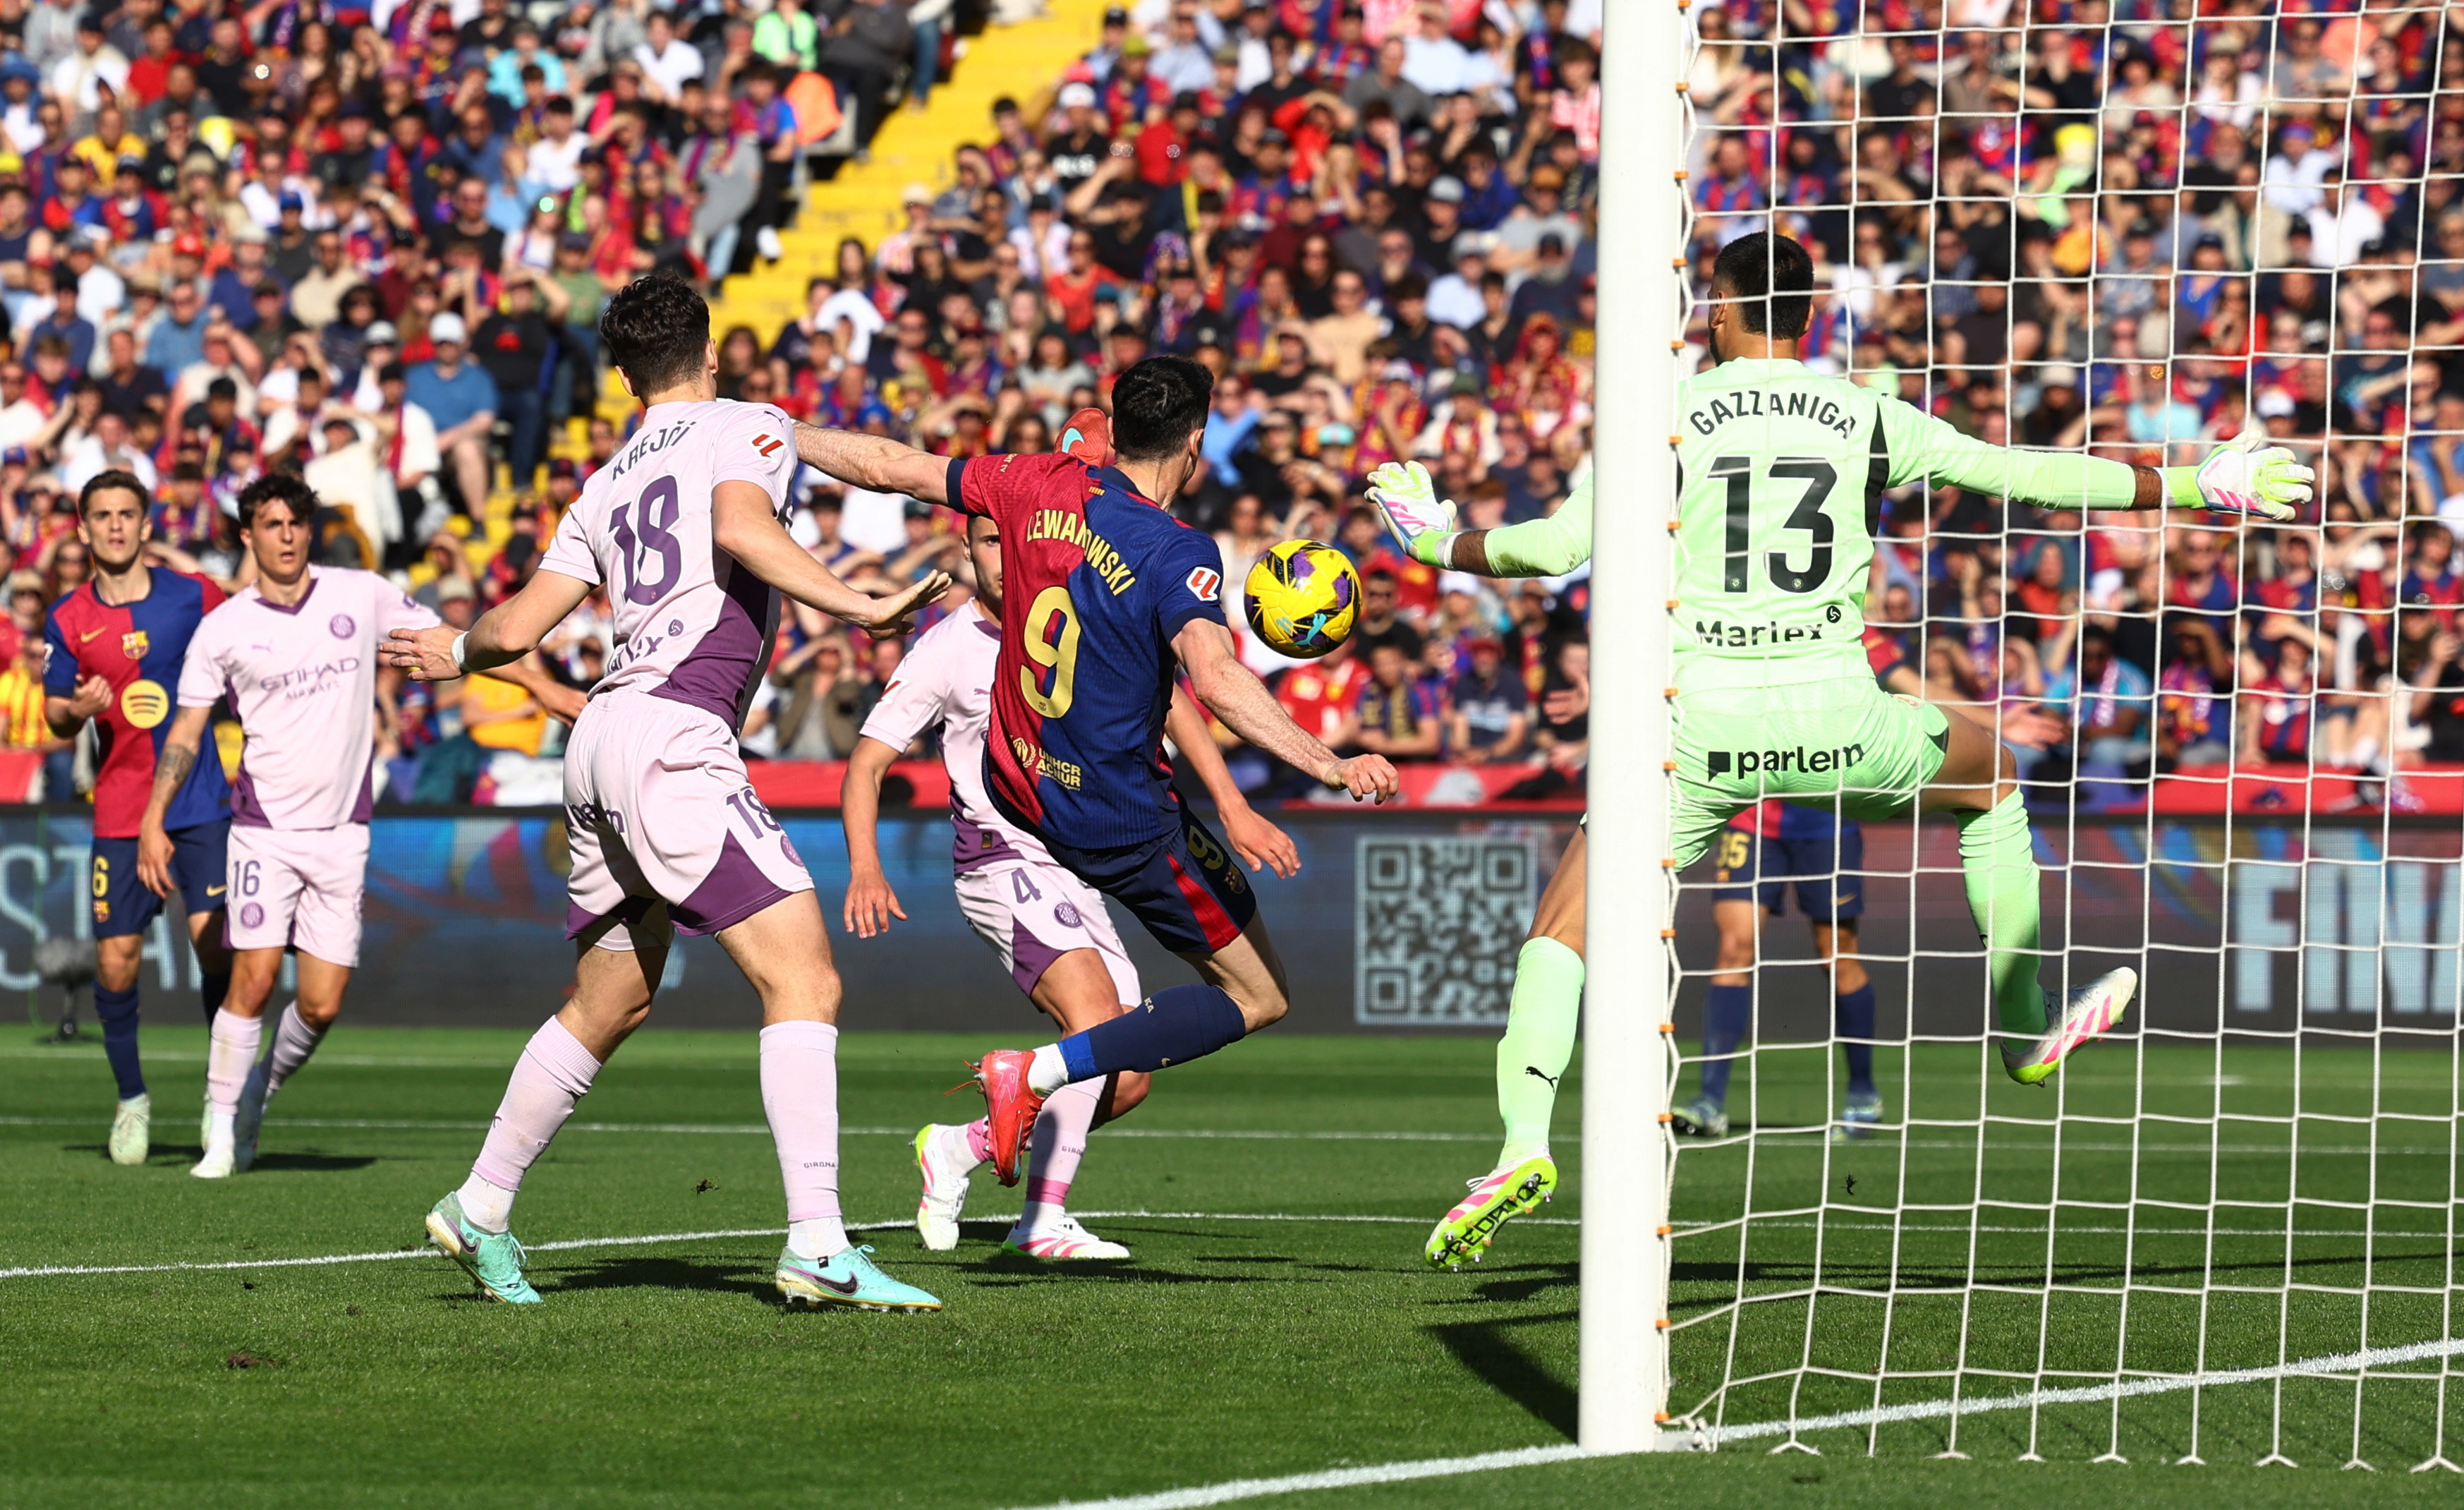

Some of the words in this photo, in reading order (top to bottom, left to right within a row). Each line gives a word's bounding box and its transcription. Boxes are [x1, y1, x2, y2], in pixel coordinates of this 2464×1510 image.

[1689, 389, 1857, 440] GAZZANIGA
[607, 474, 682, 607] 18
[1706, 457, 1838, 593] 13
[1020, 586, 1081, 719] 9
[1696, 620, 1823, 647] Marlex
[260, 657, 360, 692] ETIHAD
[1737, 743, 1864, 780] parlem
[726, 789, 781, 840] 18
[1188, 825, 1224, 870] 9
[92, 854, 109, 898] 6
[233, 859, 262, 900] 16
[1011, 867, 1043, 905] 4
[803, 1161, 836, 1169] GIRONA
